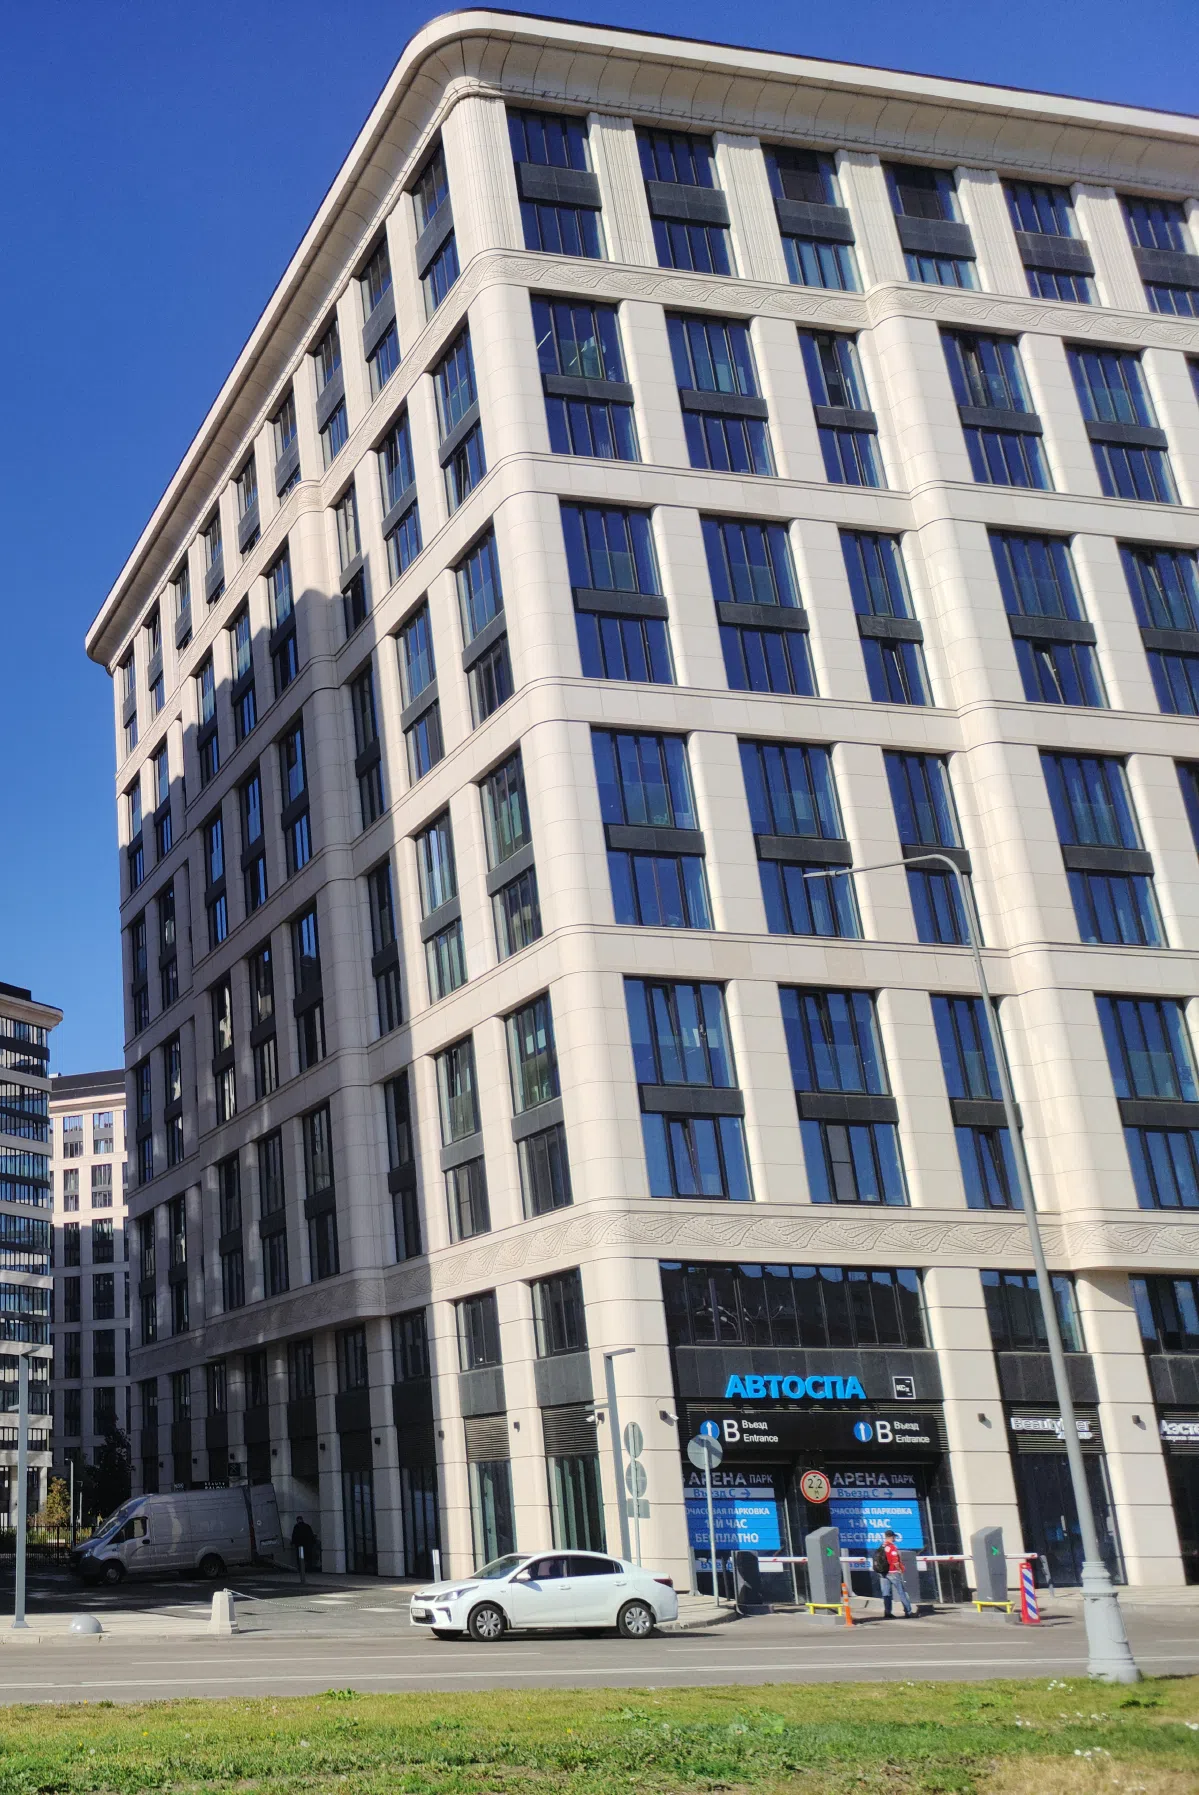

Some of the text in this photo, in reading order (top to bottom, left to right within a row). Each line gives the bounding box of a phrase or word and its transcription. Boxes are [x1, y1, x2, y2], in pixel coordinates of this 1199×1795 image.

[725, 1375, 866, 1399] АВТОСПА
[742, 1420, 768, 1430] Въезд
[894, 1421, 919, 1431] Въезд
[743, 1434, 779, 1443] Entrance
[895, 1434, 930, 1443] Entrance
[749, 1474, 774, 1484] ПАРК
[832, 1472, 915, 1486] АРЕНА ПАРК
[693, 1488, 727, 1498] Възд
[837, 1488, 870, 1498] Въезд
[728, 1507, 770, 1515] ПАРКОВКА
[871, 1507, 913, 1515] ПАРКОВКА
[726, 1519, 748, 1529] ЧАС
[869, 1519, 891, 1528] ЧАС
[695, 1532, 759, 1543] БЕПЛАТНО
[840, 1532, 903, 1543] БЕСПЛАТО
